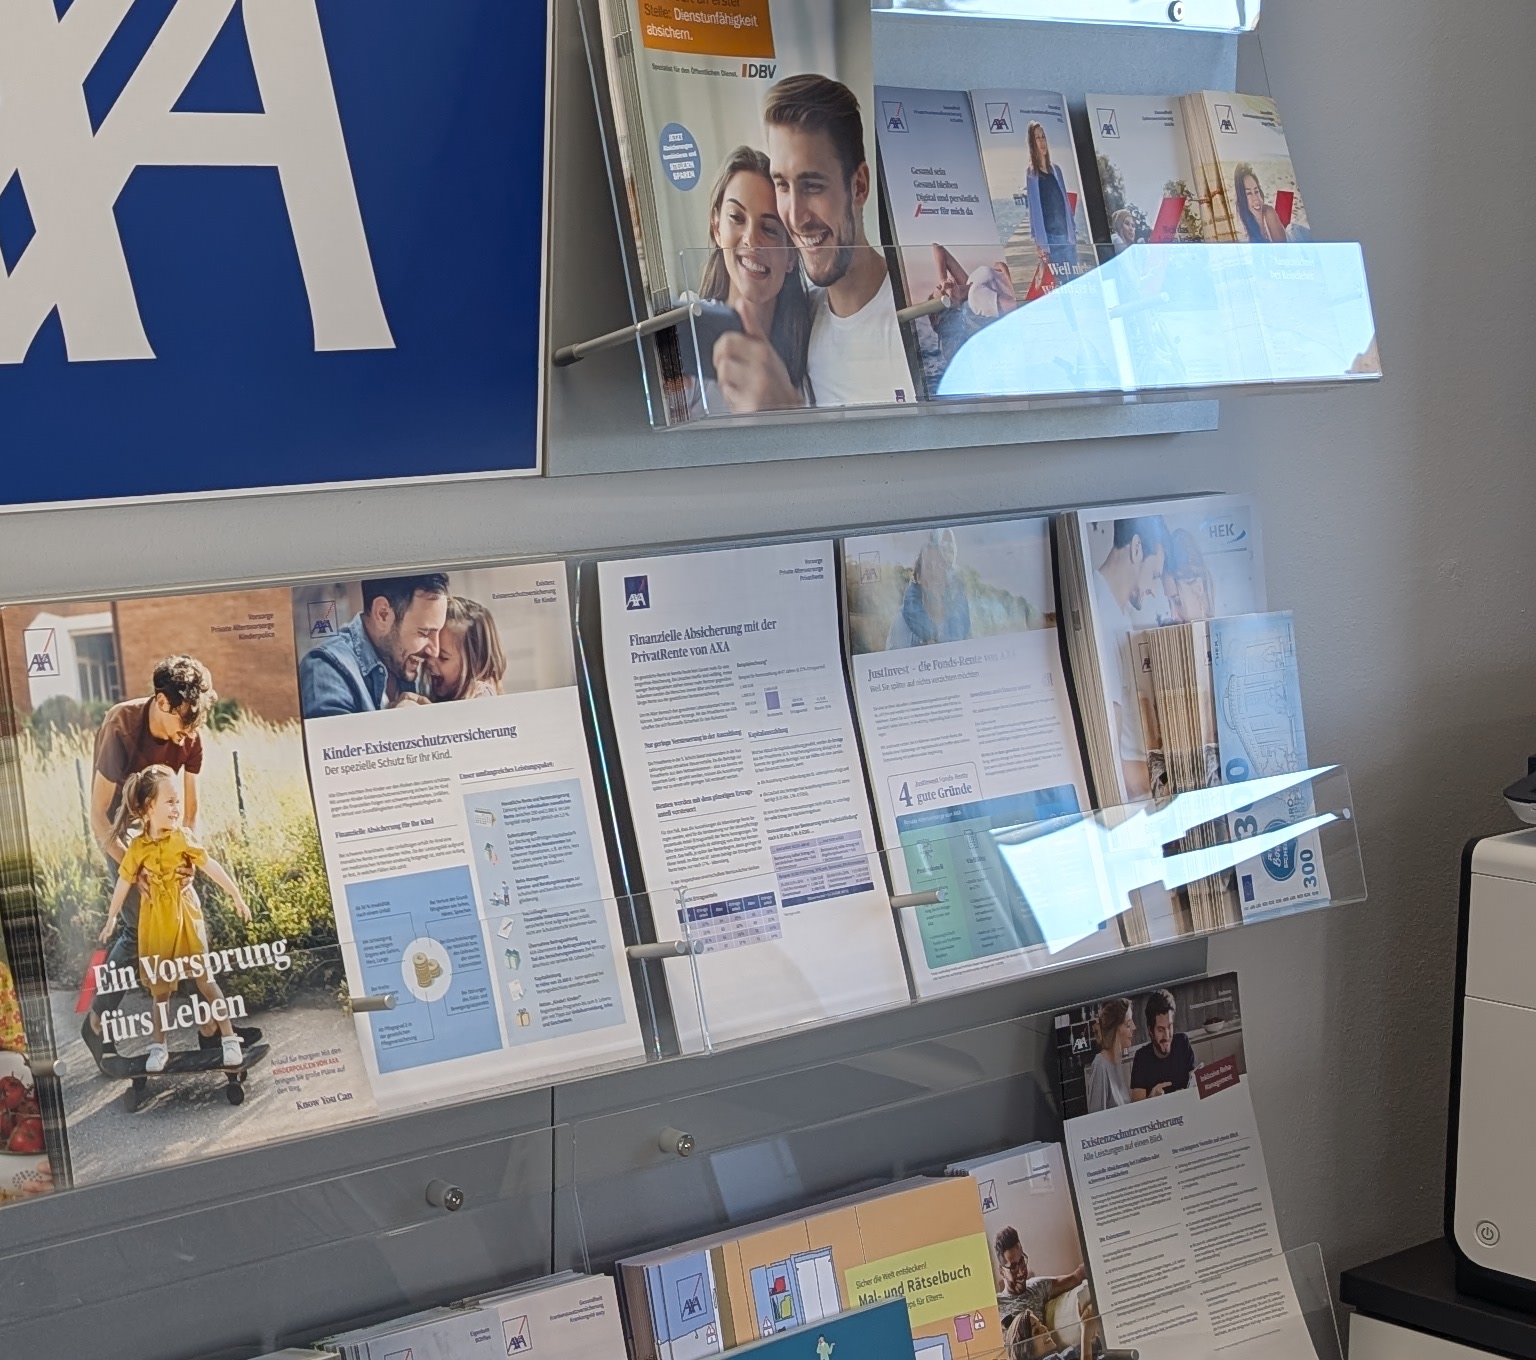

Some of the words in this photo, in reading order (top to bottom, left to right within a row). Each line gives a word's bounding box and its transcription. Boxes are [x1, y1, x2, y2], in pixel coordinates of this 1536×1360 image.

[644, 3, 672, 20] Stelle:
[673, 7, 759, 29] Dienstunfähigkeit
[646, 23, 694, 41] absichern.
[747, 63, 777, 80] DBV
[910, 166, 933, 176] Gesund
[934, 167, 947, 176] sein
[913, 180, 937, 189] Gesund
[937, 180, 958, 189] bleiben
[916, 193, 936, 205] Digital
[937, 193, 949, 202] und
[949, 193, 980, 204] persönlich
[1208, 523, 1235, 538] HEK
[628, 629, 682, 648] Finanzielle
[683, 622, 743, 642] Absicherung
[744, 619, 761, 633] mit
[761, 618, 777, 632] der
[630, 646, 689, 664] PrivatRente
[689, 644, 708, 656] von
[709, 640, 731, 654] AXA
[867, 664, 910, 682] JustInvest
[918, 660, 931, 673] die
[932, 654, 983, 671] Fonds-Rente
[322, 723, 518, 761] Kinder-Existenzschutzversicherung
[324, 764, 339, 776] Der
[340, 757, 376, 775] spezielle
[377, 754, 405, 769] Schutz
[406, 753, 418, 765] für
[419, 751, 430, 762] Ihr
[431, 749, 453, 762] Kind.
[898, 781, 914, 807] 4
[916, 791, 937, 806] gute
[937, 782, 973, 799] Gründe
[1299, 848, 1318, 889] 300
[92, 961, 136, 996] Ein
[139, 938, 292, 987] Vorsprung
[100, 1009, 154, 1044] fürs
[156, 994, 249, 1034] Leben
[295, 1099, 320, 1110] Know
[320, 1095, 337, 1105] You
[337, 1092, 354, 1102] Can
[1081, 1115, 1185, 1151] Existenzschutzversicherung
[1083, 1152, 1095, 1162] Alle
[1094, 1144, 1124, 1160] Leistungen
[1124, 1141, 1134, 1151] auf
[1134, 1138, 1150, 1148] einen
[1149, 1133, 1163, 1144] Blick
[855, 1278, 873, 1290] Sicher
[873, 1274, 882, 1284] die
[881, 1270, 896, 1282] Welt
[895, 1261, 928, 1278] entdecken!
[858, 1289, 882, 1307] Mal-
[883, 1281, 906, 1300] und
[907, 1264, 973, 1293] Rätselbuch
